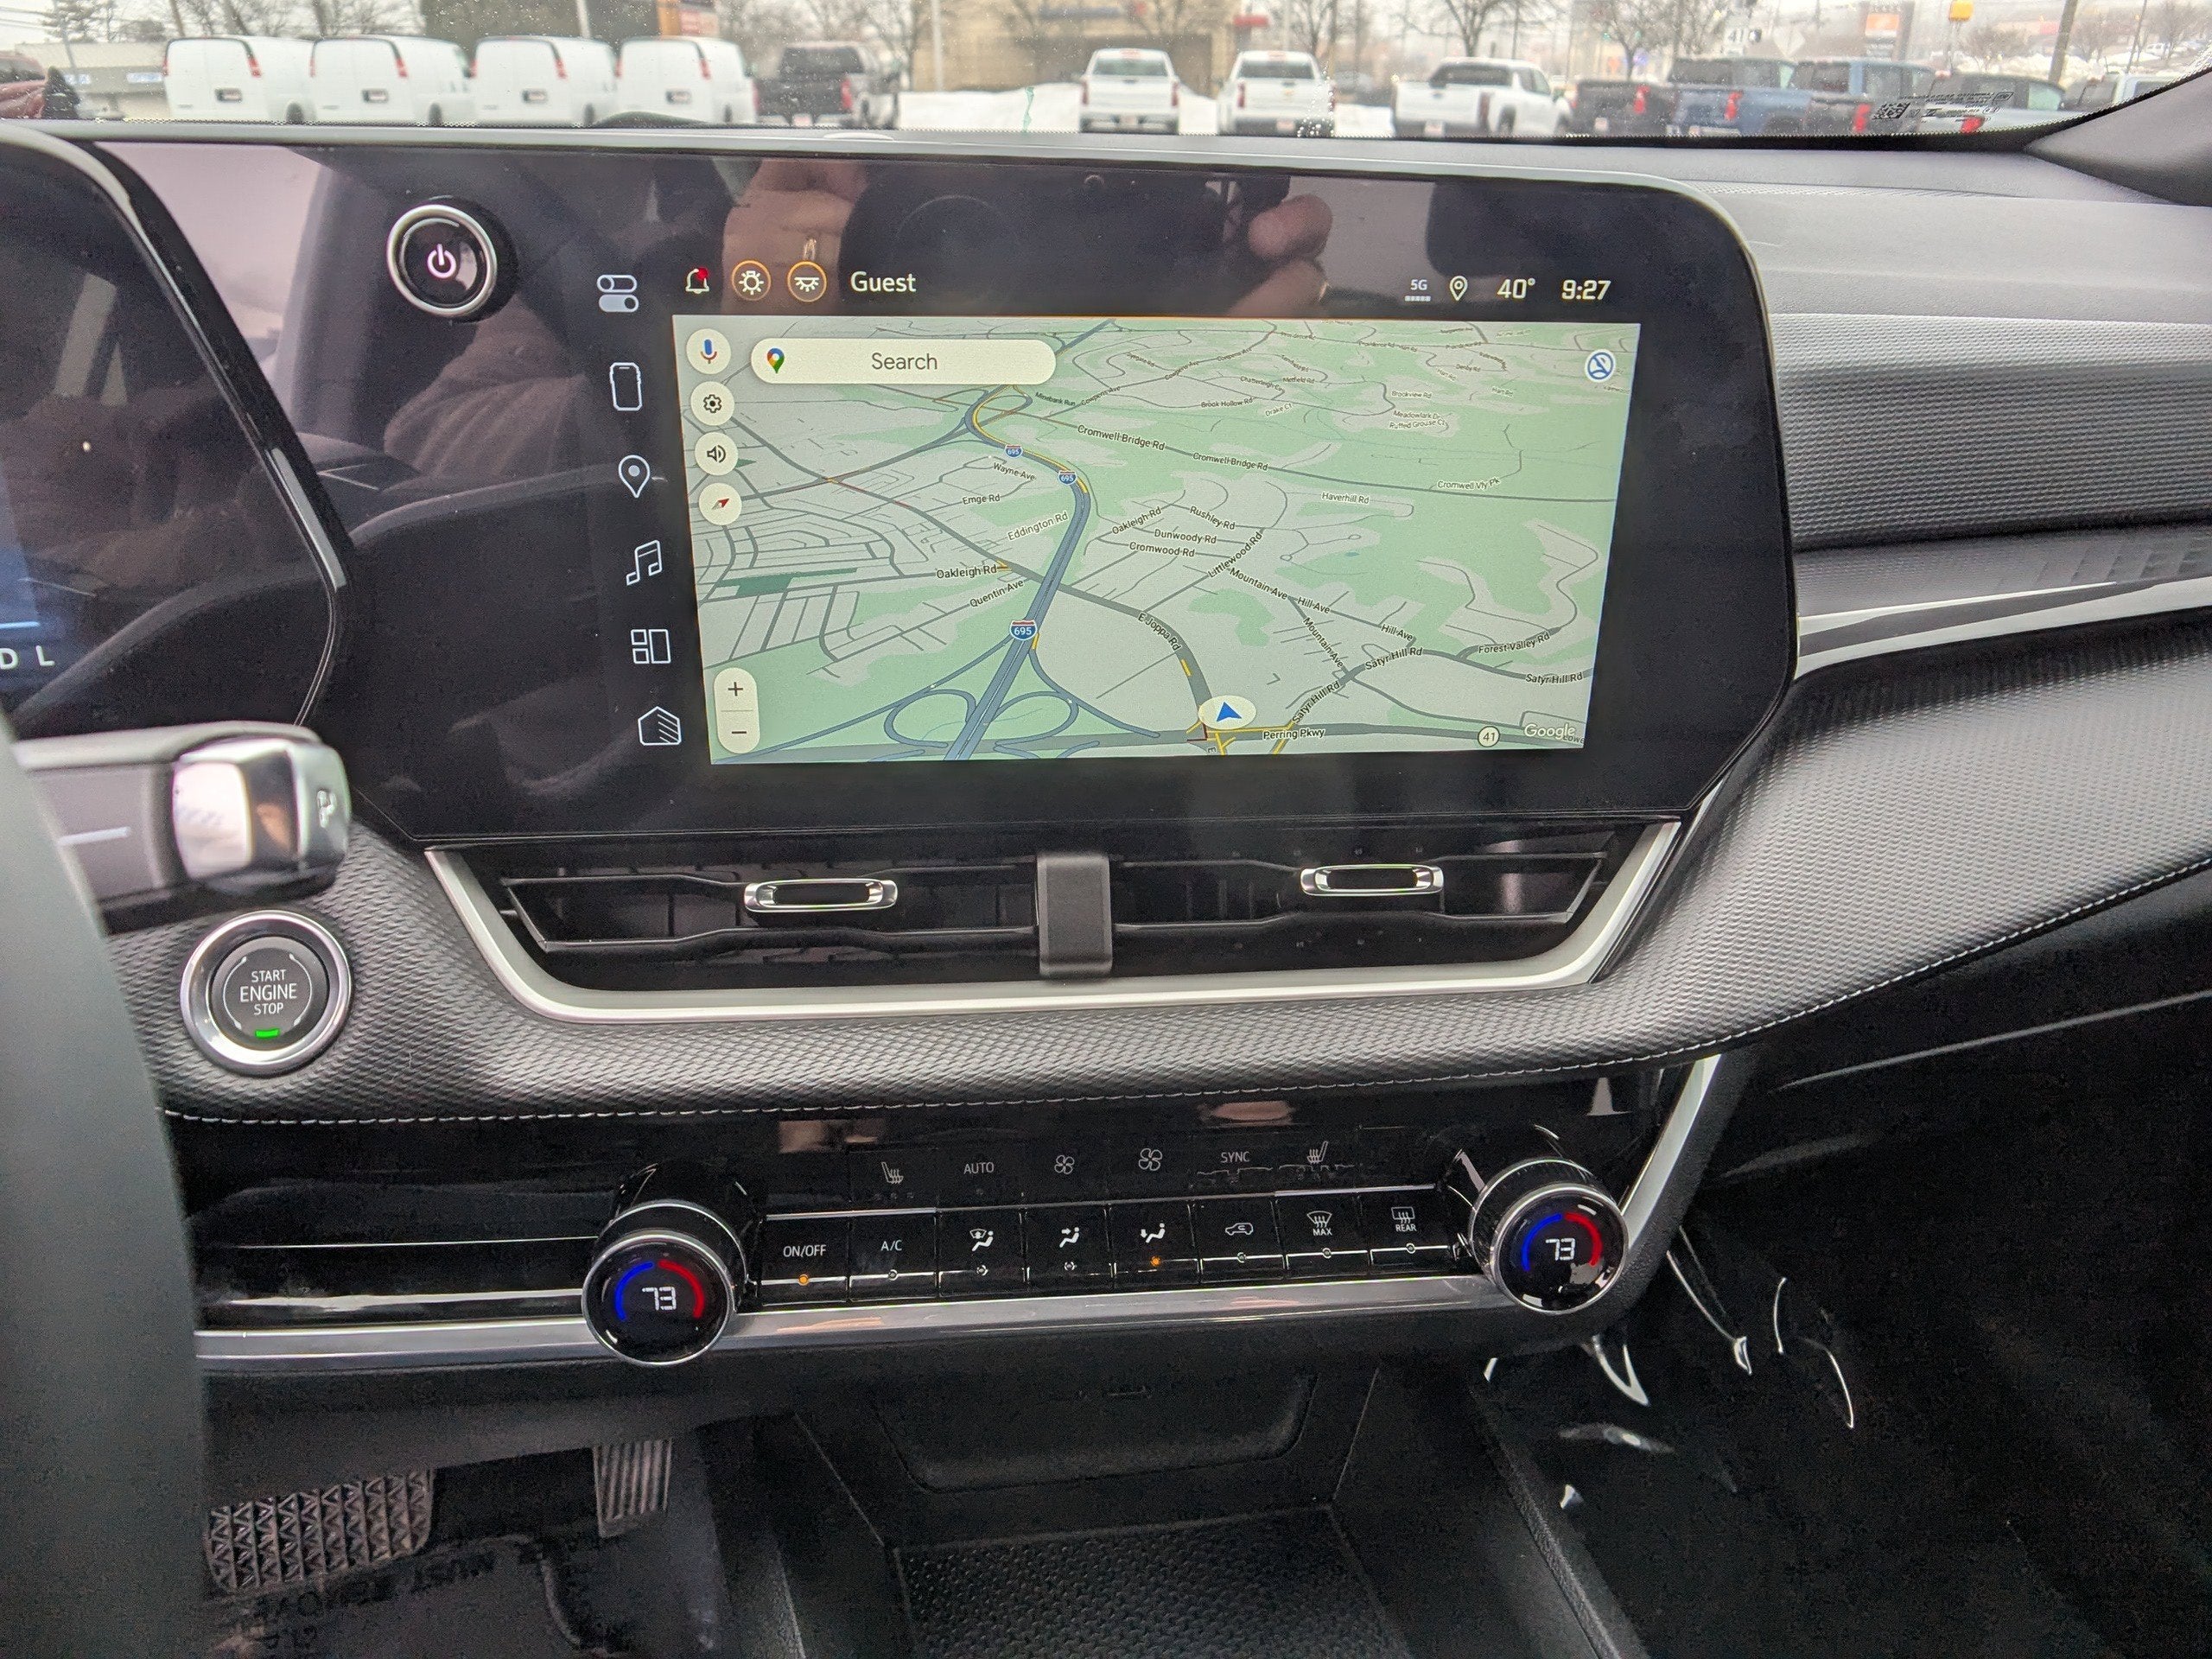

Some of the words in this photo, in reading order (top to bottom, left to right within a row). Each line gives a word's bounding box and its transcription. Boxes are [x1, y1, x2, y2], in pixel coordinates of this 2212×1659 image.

[850, 270, 917, 292] Guest
[1410, 279, 1427, 290] 5G
[1497, 277, 1535, 299] 40°
[1561, 279, 1611, 300] 9:27
[872, 353, 938, 370] Search
[1035, 391, 1062, 404] Minebank
[1081, 391, 1107, 405] Cowpens
[1221, 398, 1243, 407] Hollow
[1266, 407, 1283, 416] Drake
[1394, 410, 1431, 419] Meadowlark
[1077, 424, 1121, 442] Cromwell
[1122, 434, 1151, 450] Bridge
[1152, 441, 1166, 450] Rd
[1193, 453, 1229, 465] Cromwell
[1230, 458, 1255, 469] Bridge
[993, 462, 1019, 478] Wayne
[1020, 470, 1035, 480] Ave
[1438, 480, 1474, 489] Cromwell
[963, 496, 987, 505] Emge
[988, 493, 1001, 503] Rd
[1322, 493, 1357, 503] Haverhill
[1358, 495, 1370, 504] Rd
[1007, 518, 1053, 540] Eddington
[1055, 512, 1068, 523] Rd
[1112, 513, 1148, 534] Oakleigh
[1149, 506, 1161, 519] Rd
[1190, 506, 1222, 528] Rushley
[1223, 520, 1236, 530] Rd
[1154, 530, 1202, 543] Dunwoody
[1205, 535, 1217, 544] Rd
[1129, 542, 1181, 556] Cromwood
[1183, 548, 1195, 557] Rd
[1208, 543, 1250, 577] Littlewood
[1249, 531, 1262, 546] Rd
[937, 565, 981, 579] Oakleigh
[983, 565, 997, 575] Rd
[1230, 567, 1270, 593] Mountain
[1271, 588, 1287, 600] Ave
[969, 588, 1005, 607] Quentin
[1007, 580, 1024, 593] Ave
[1298, 596, 1313, 607] Hill
[1313, 603, 1330, 613] Ave
[1014, 626, 1033, 636] 695
[1138, 613, 1146, 621] E
[1146, 617, 1171, 640] Joppa
[1168, 637, 1181, 651] Rd
[1382, 624, 1396, 635] Hill
[1396, 630, 1413, 641] Ave
[1303, 617, 1332, 654] Mountain
[1330, 652, 1344, 668] Ave
[1478, 645, 1507, 653] Forest
[1510, 639, 1535, 652] Valley
[1538, 632, 1550, 643] Rd
[0, 647, 18, 670] D
[35, 645, 54, 667] L
[1365, 657, 1389, 670] Satyr
[1390, 649, 1408, 660] Hill
[1409, 647, 1422, 657] Rd
[1526, 674, 1551, 685] Satyr
[1552, 675, 1568, 683] Hill
[1570, 672, 1583, 682] Rd
[1293, 703, 1312, 723] Satyr
[1310, 689, 1327, 703] Hill
[1326, 681, 1340, 692] Rd
[1263, 730, 1298, 740] Perring
[1300, 728, 1325, 738] Pkwy
[1483, 732, 1496, 741] 41
[1524, 723, 1576, 739] Google
[316, 789, 336, 828] P
[251, 969, 287, 982] START
[239, 983, 297, 1002] ENGINE
[253, 1003, 284, 1015] STOP
[1221, 1152, 1250, 1163] SYNC
[963, 1161, 995, 1174] AUTO
[1313, 1227, 1332, 1236] MAX
[1395, 1224, 1417, 1232] REAR
[783, 1244, 827, 1257] ON/OFF
[880, 1240, 902, 1253] A/C
[1546, 1238, 1575, 1261] 73
[641, 1287, 677, 1311] 73
